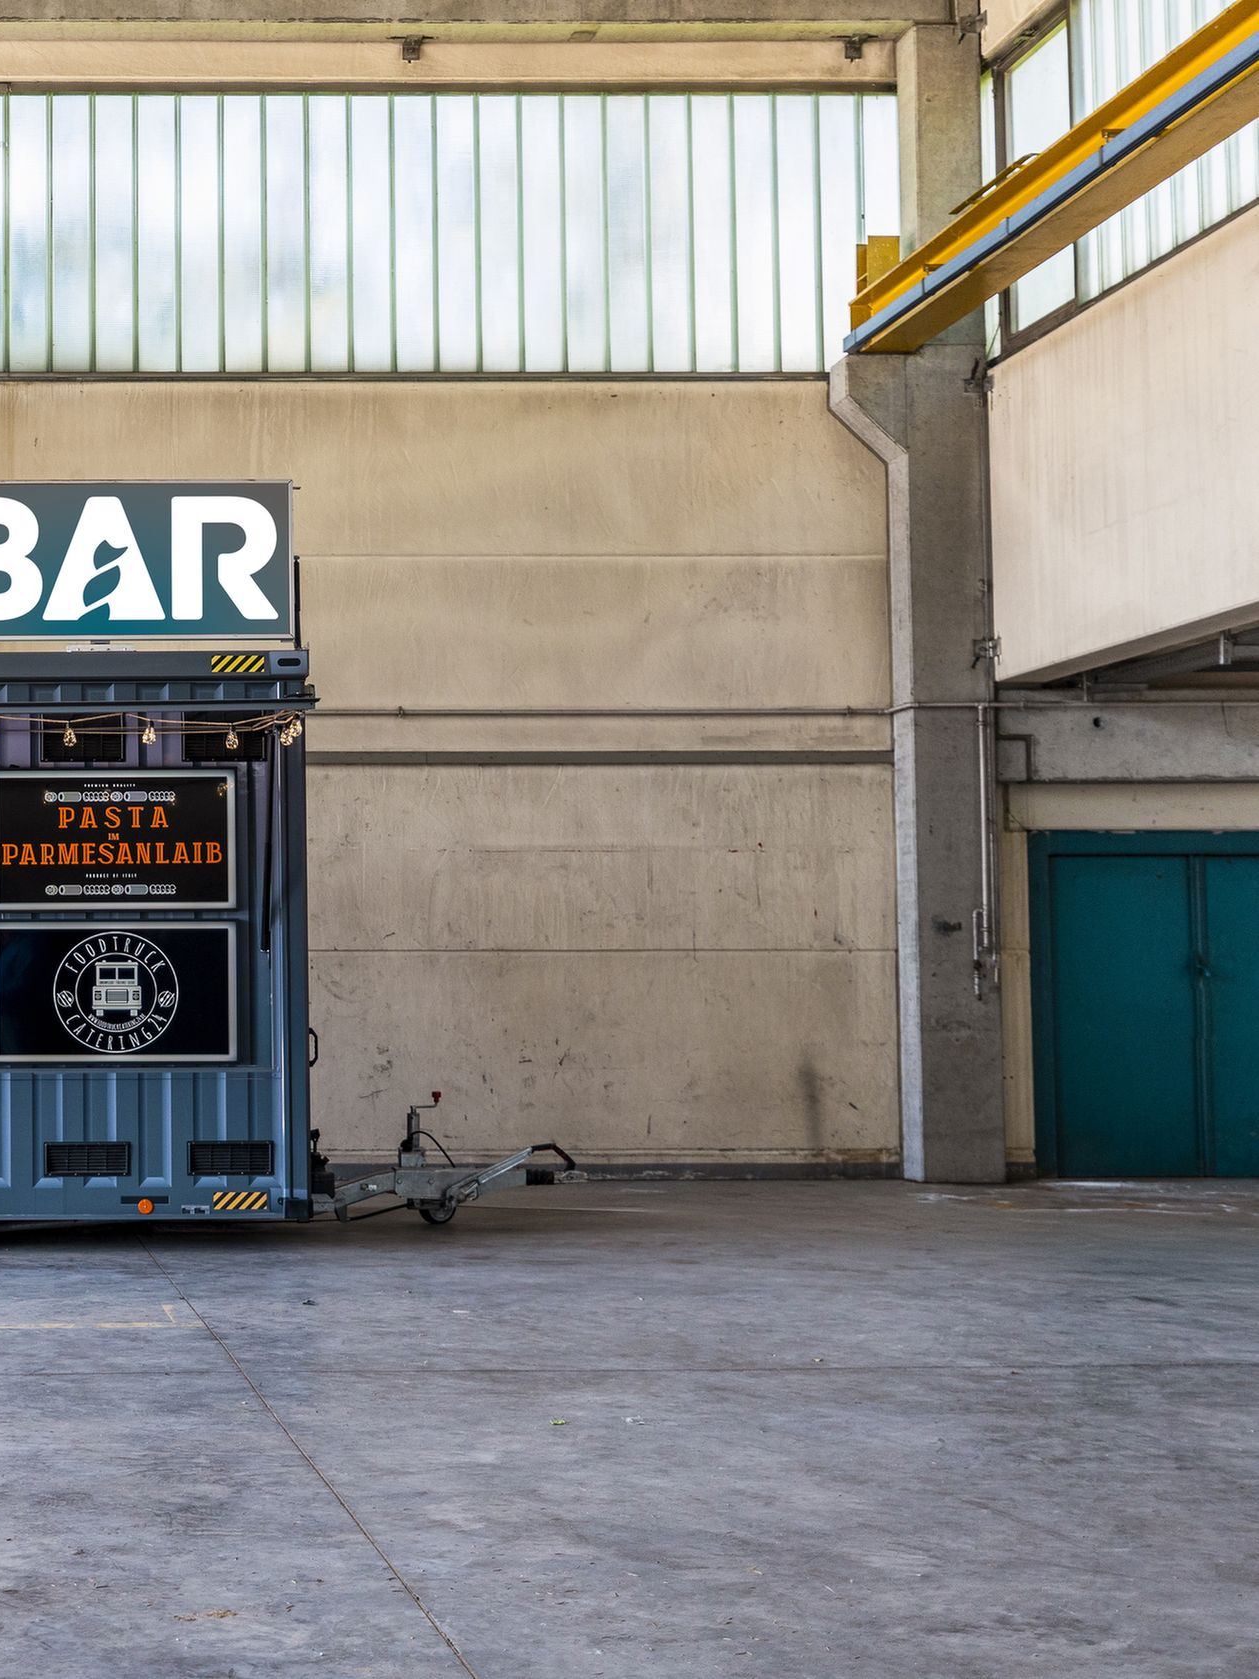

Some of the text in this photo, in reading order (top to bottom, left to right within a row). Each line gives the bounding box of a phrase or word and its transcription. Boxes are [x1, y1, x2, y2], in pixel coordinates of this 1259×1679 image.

[58, 806, 169, 829] PASTA
[108, 832, 120, 841] IM
[1, 842, 223, 866] PARMESANLAIB
[65, 936, 166, 974] FOODTRUCK
[65, 1013, 168, 1051] CATERING24
